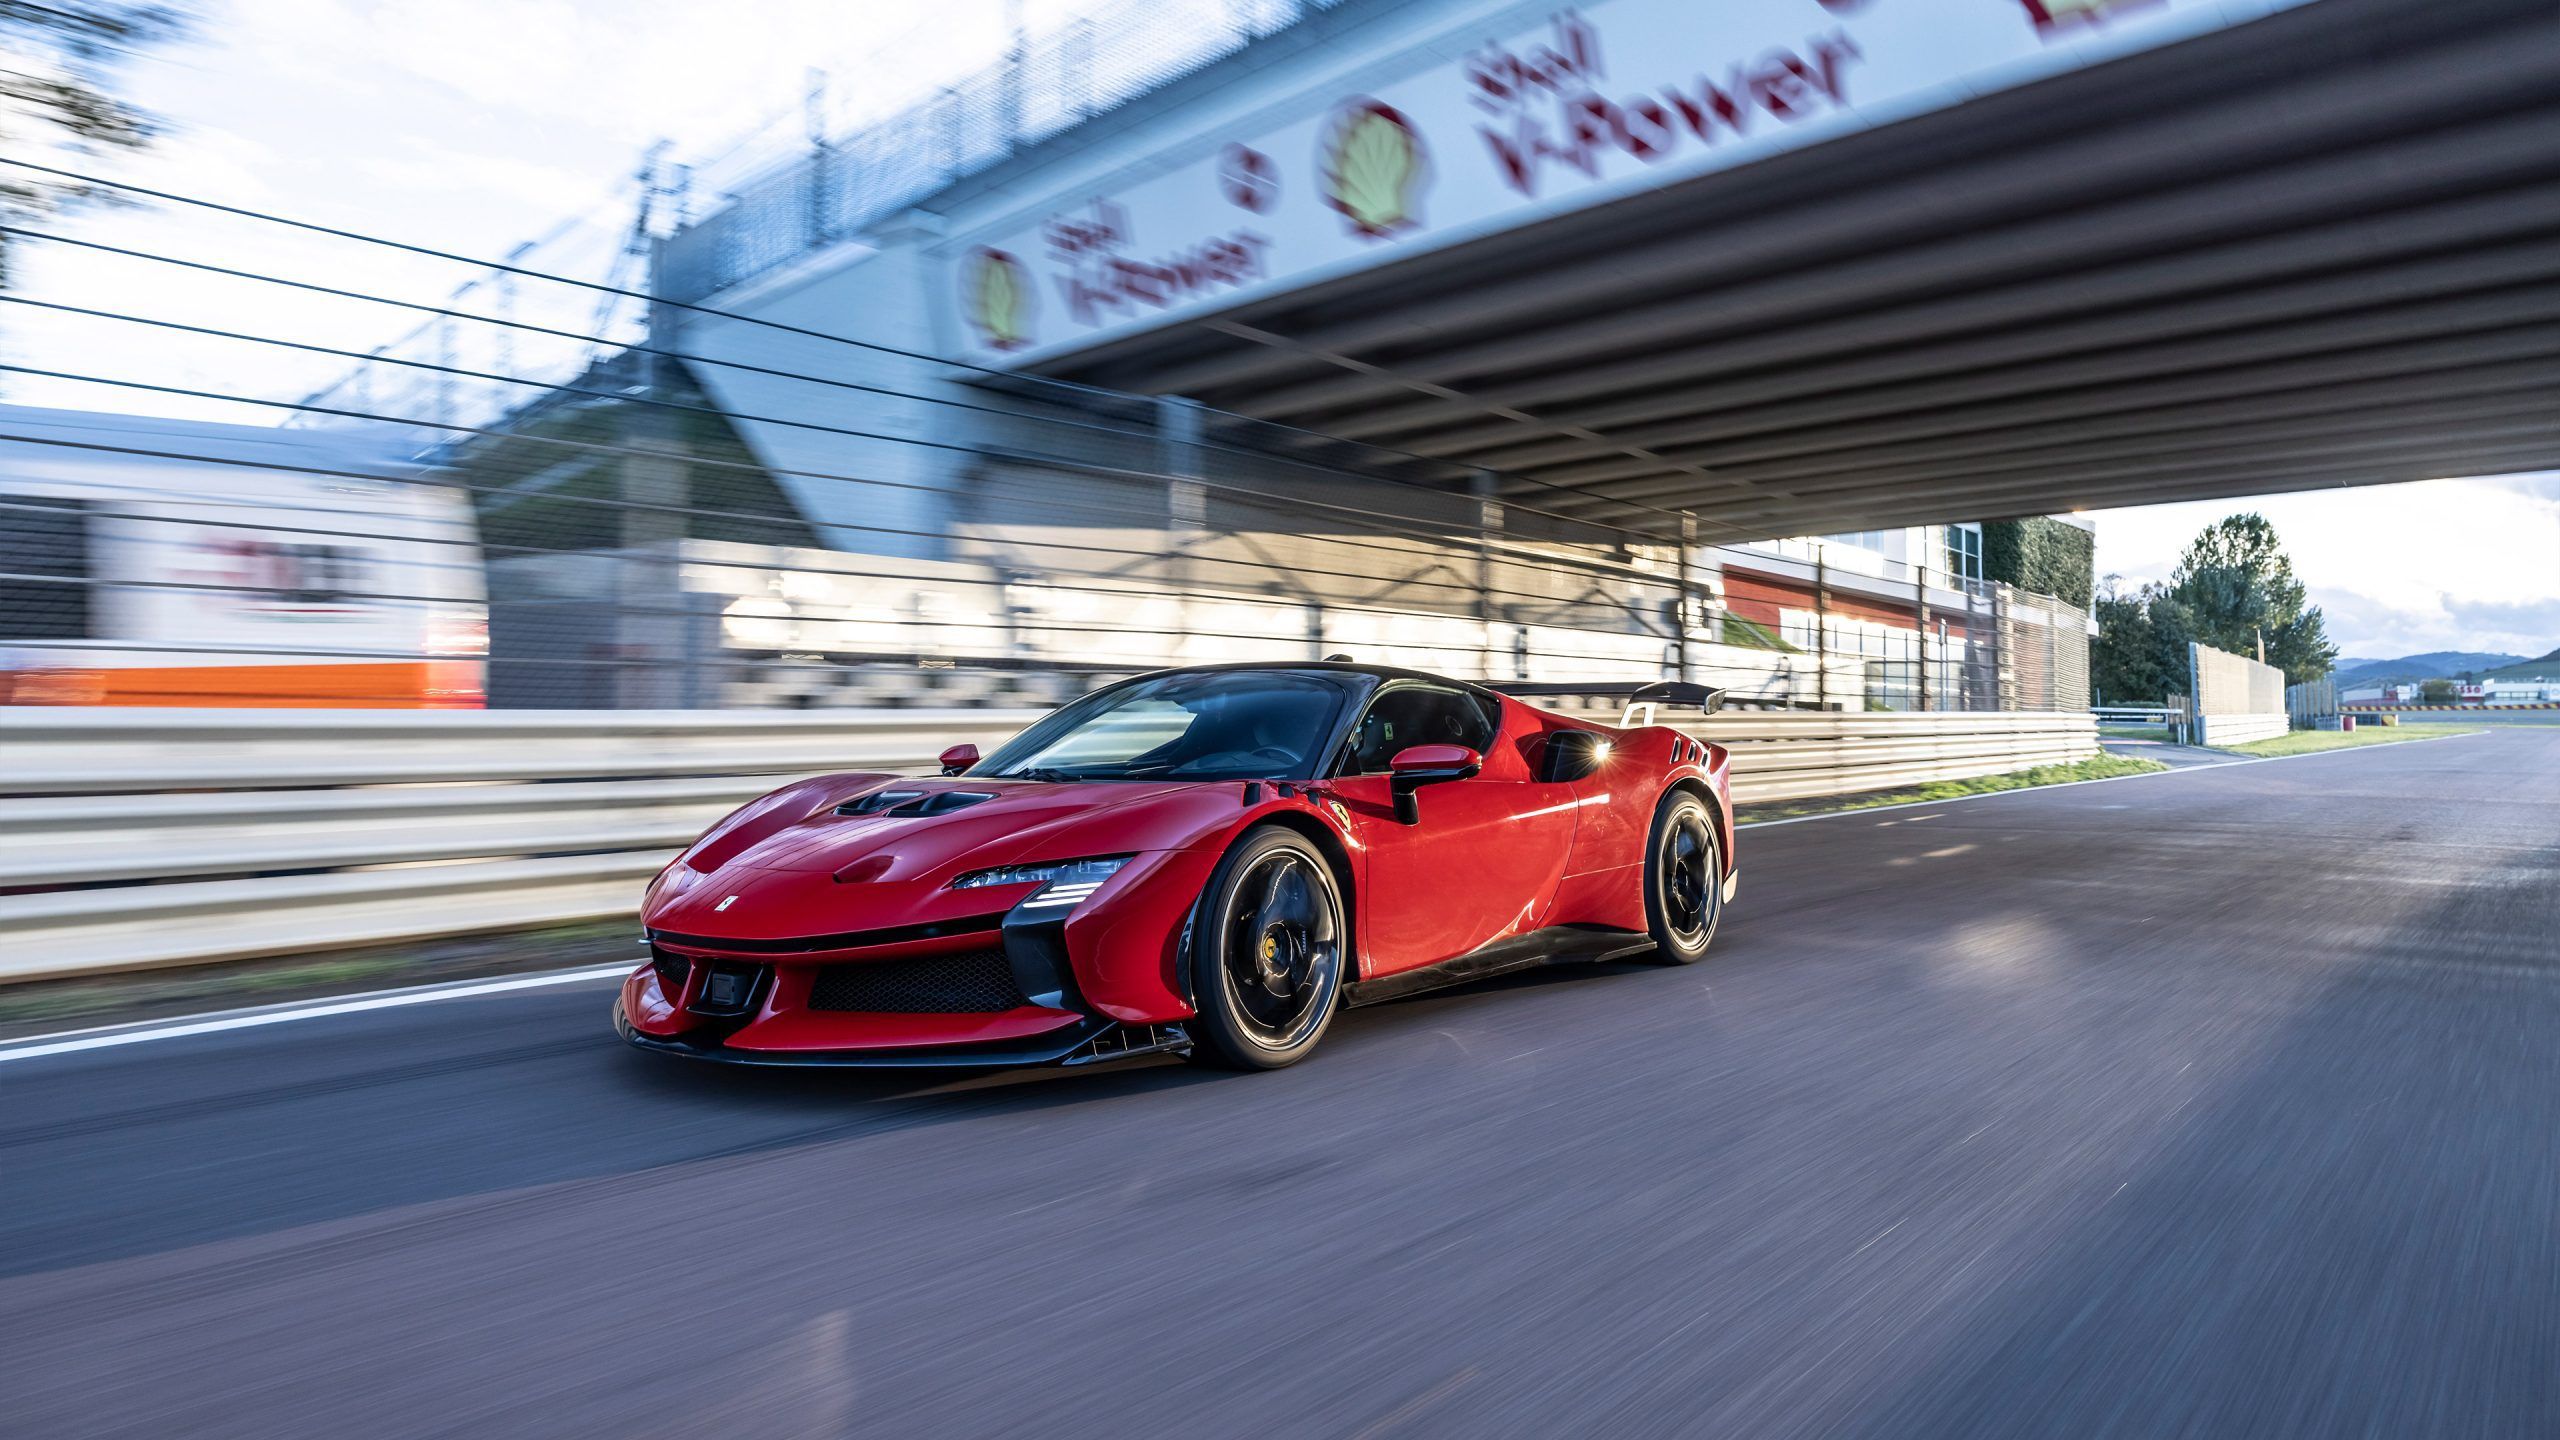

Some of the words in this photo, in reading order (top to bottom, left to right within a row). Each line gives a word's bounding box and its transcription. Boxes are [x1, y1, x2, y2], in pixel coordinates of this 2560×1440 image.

[1464, 10, 1605, 116] Shell
[1474, 28, 1862, 197] V-Power
[1055, 230, 1270, 327] V-Power
